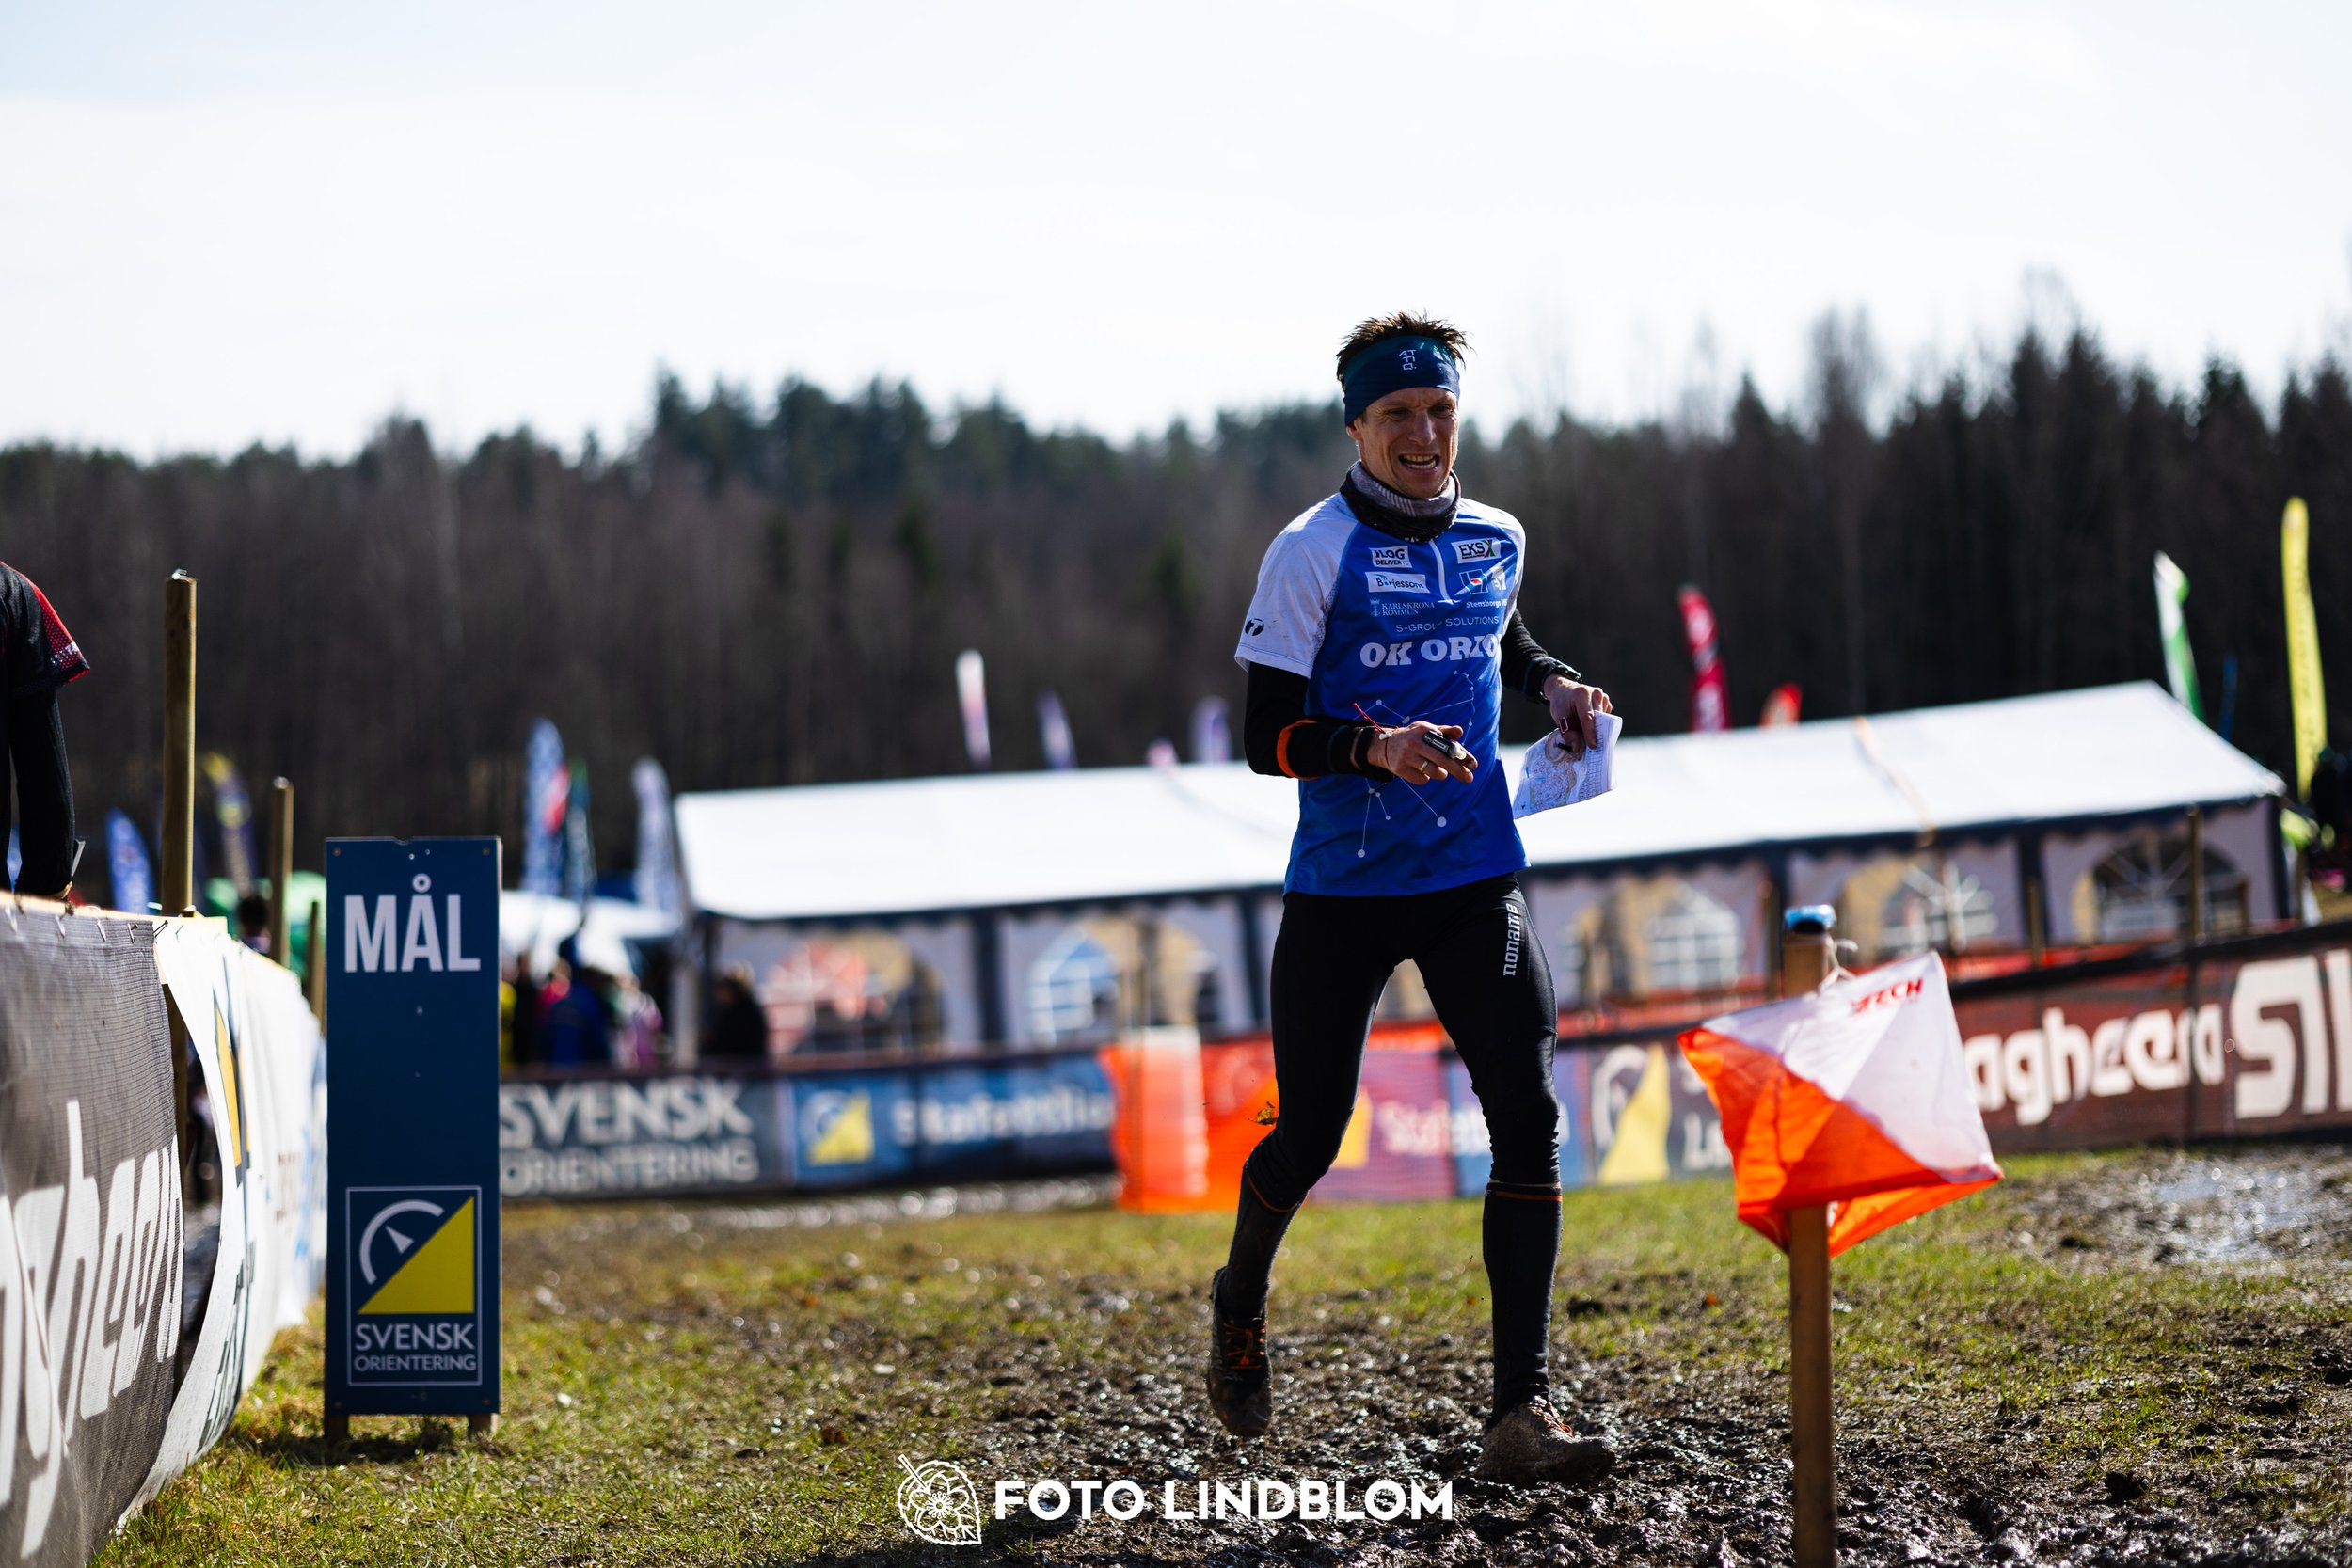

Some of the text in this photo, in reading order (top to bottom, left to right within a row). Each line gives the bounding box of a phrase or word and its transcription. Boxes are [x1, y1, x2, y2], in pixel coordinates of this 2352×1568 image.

[1381, 602, 1436, 610] KARLSKRONA
[1382, 609, 1420, 617] KOMMUN
[1445, 616, 1500, 627] SOLUTIONS
[1359, 633, 1502, 668] OK ORIO
[344, 874, 482, 973] MÅL
[1962, 1006, 2226, 1127] agheera
[355, 1322, 475, 1352] SVENSK
[354, 1354, 477, 1372] ORIENTERING
